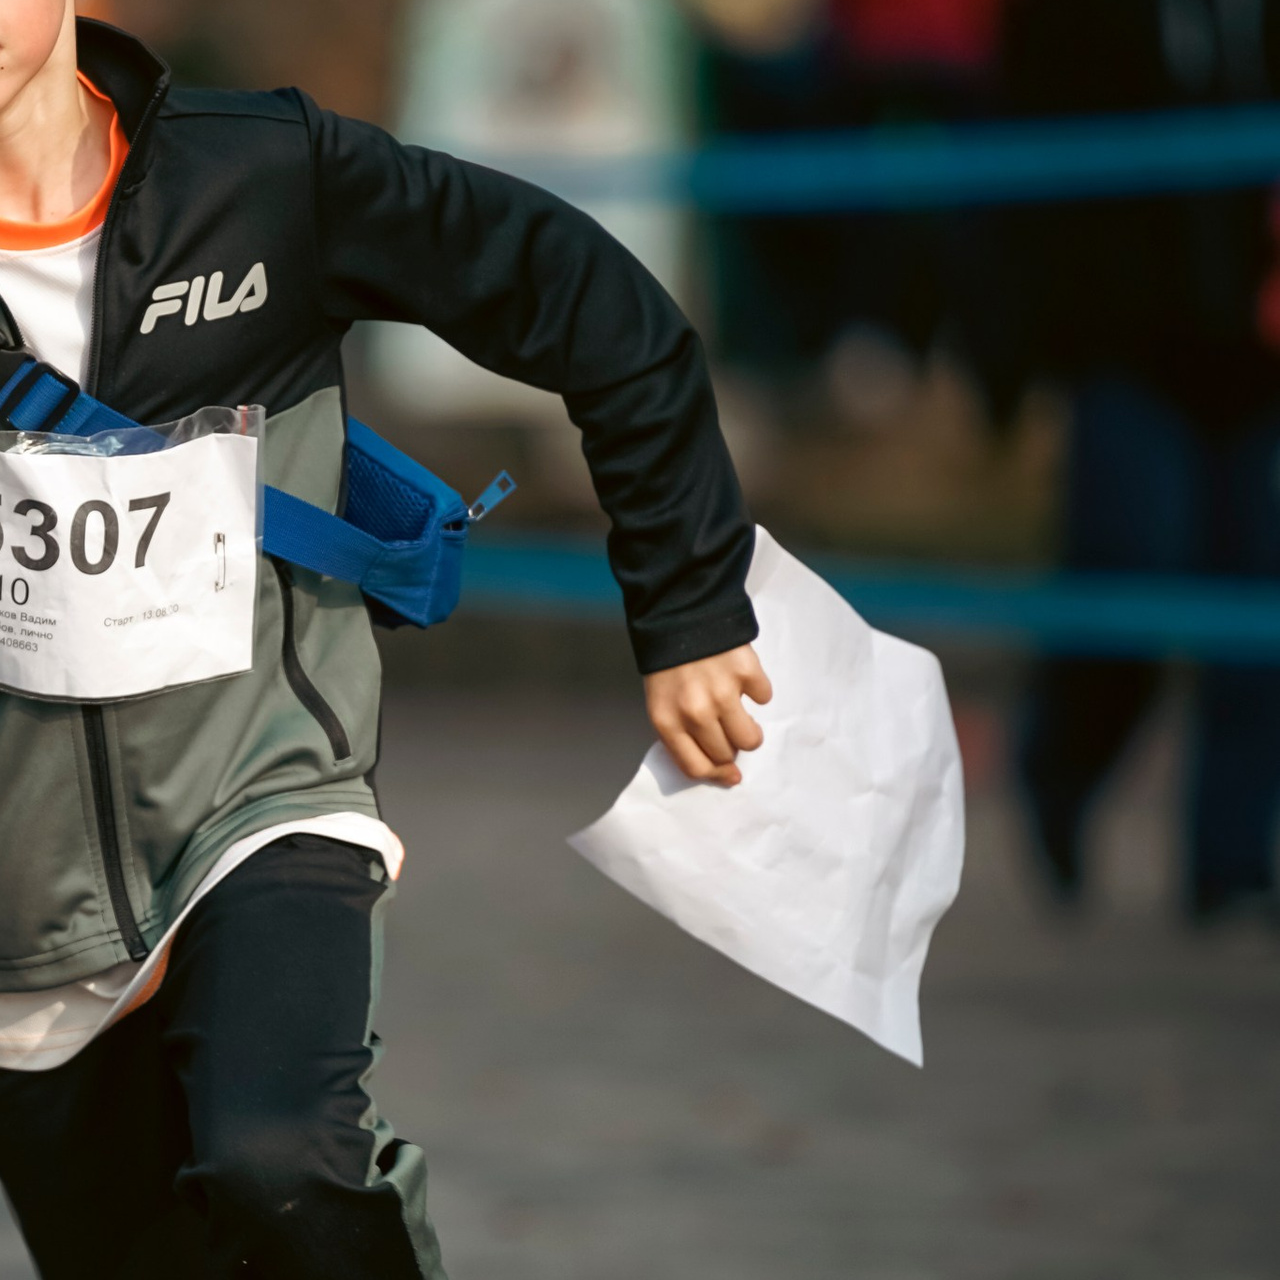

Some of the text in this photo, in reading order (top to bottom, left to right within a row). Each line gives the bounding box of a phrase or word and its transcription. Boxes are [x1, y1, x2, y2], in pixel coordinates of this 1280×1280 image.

[140, 262, 267, 334] FILA
[20, 612, 57, 626] Вадим
[103, 616, 134, 627] Старт
[20, 628, 53, 640] лично
